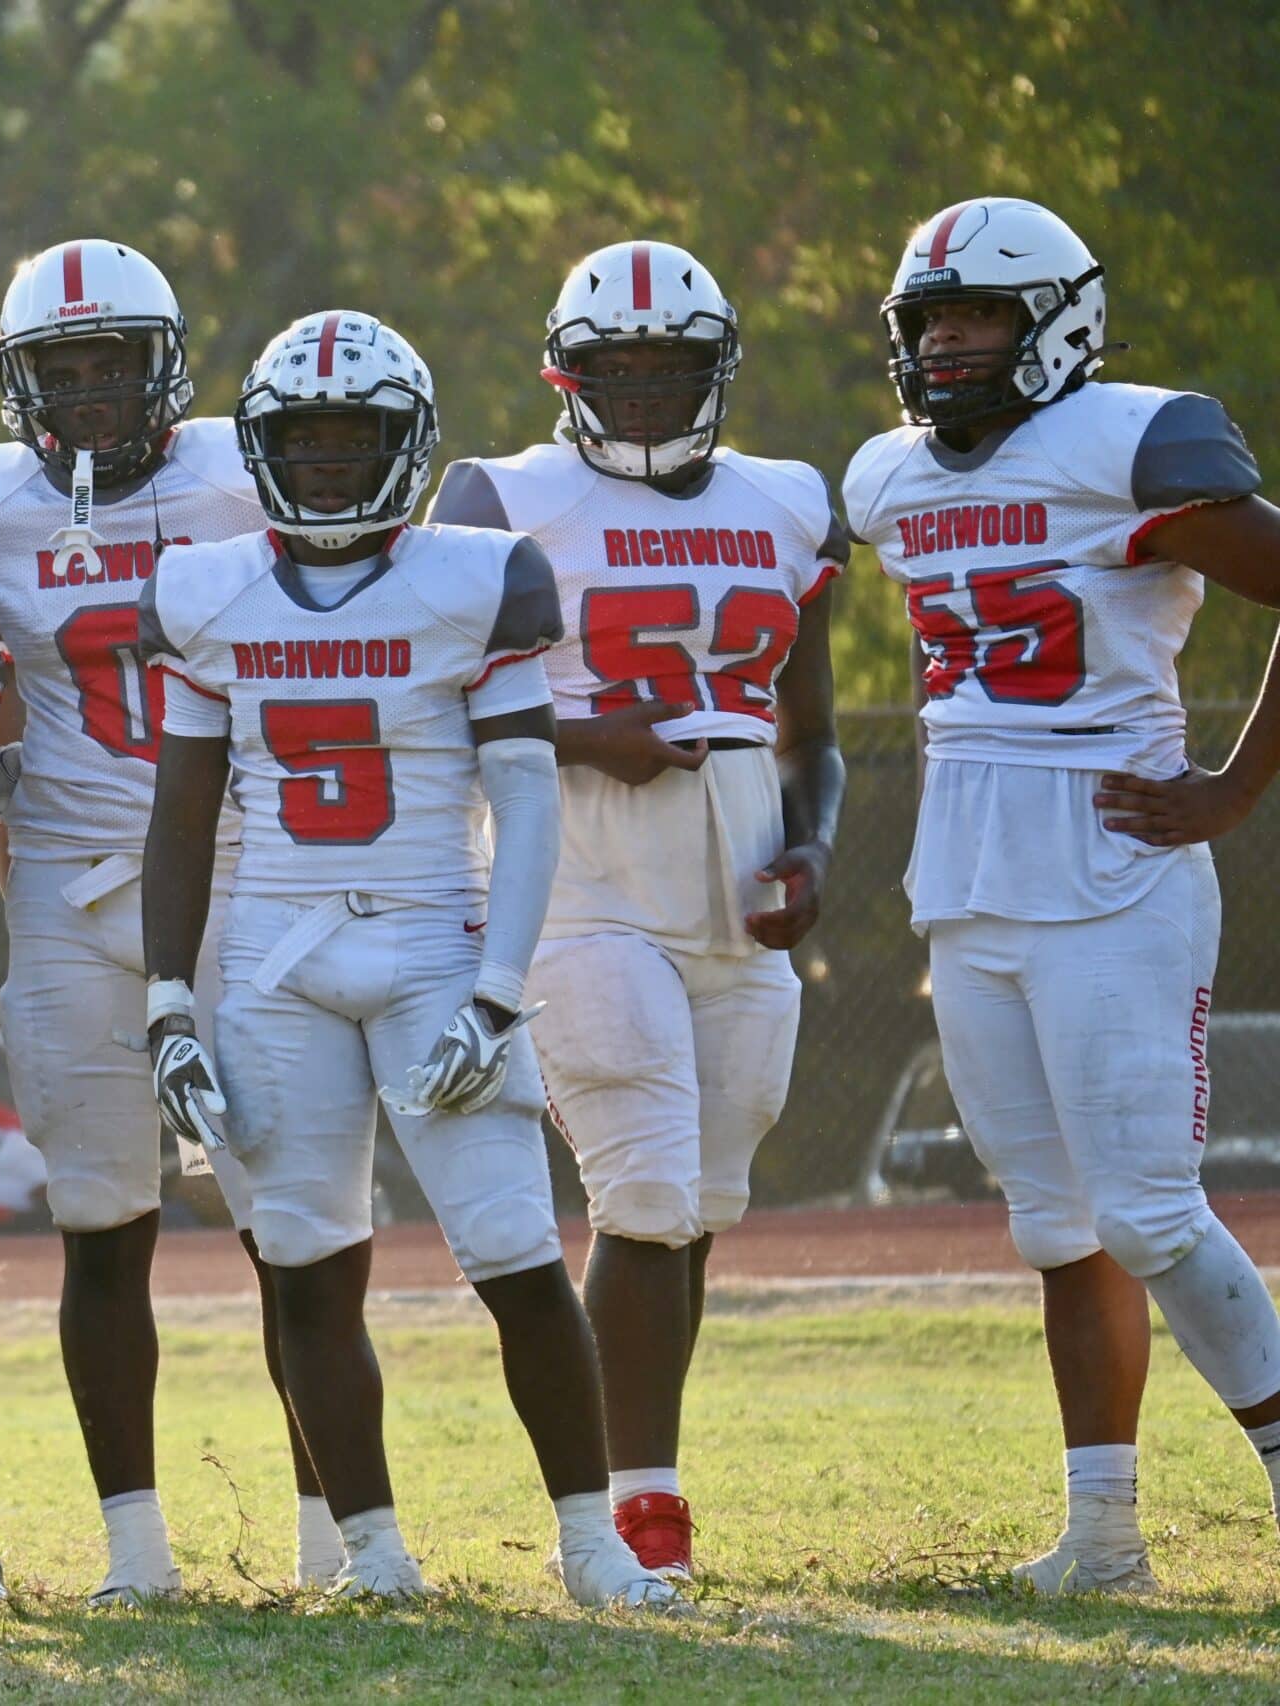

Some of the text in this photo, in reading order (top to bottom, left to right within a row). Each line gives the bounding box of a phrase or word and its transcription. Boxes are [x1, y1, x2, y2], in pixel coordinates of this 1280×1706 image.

[908, 270, 952, 286] Riddell
[58, 302, 99, 318] Riddell
[73, 485, 90, 525] NXTRND
[603, 528, 778, 570] RICHWOOD
[896, 502, 1048, 559] RICHWOOD
[579, 583, 799, 723] 52
[906, 559, 1086, 707] 55
[231, 639, 411, 679] RICHWOOD
[259, 698, 396, 846] 5
